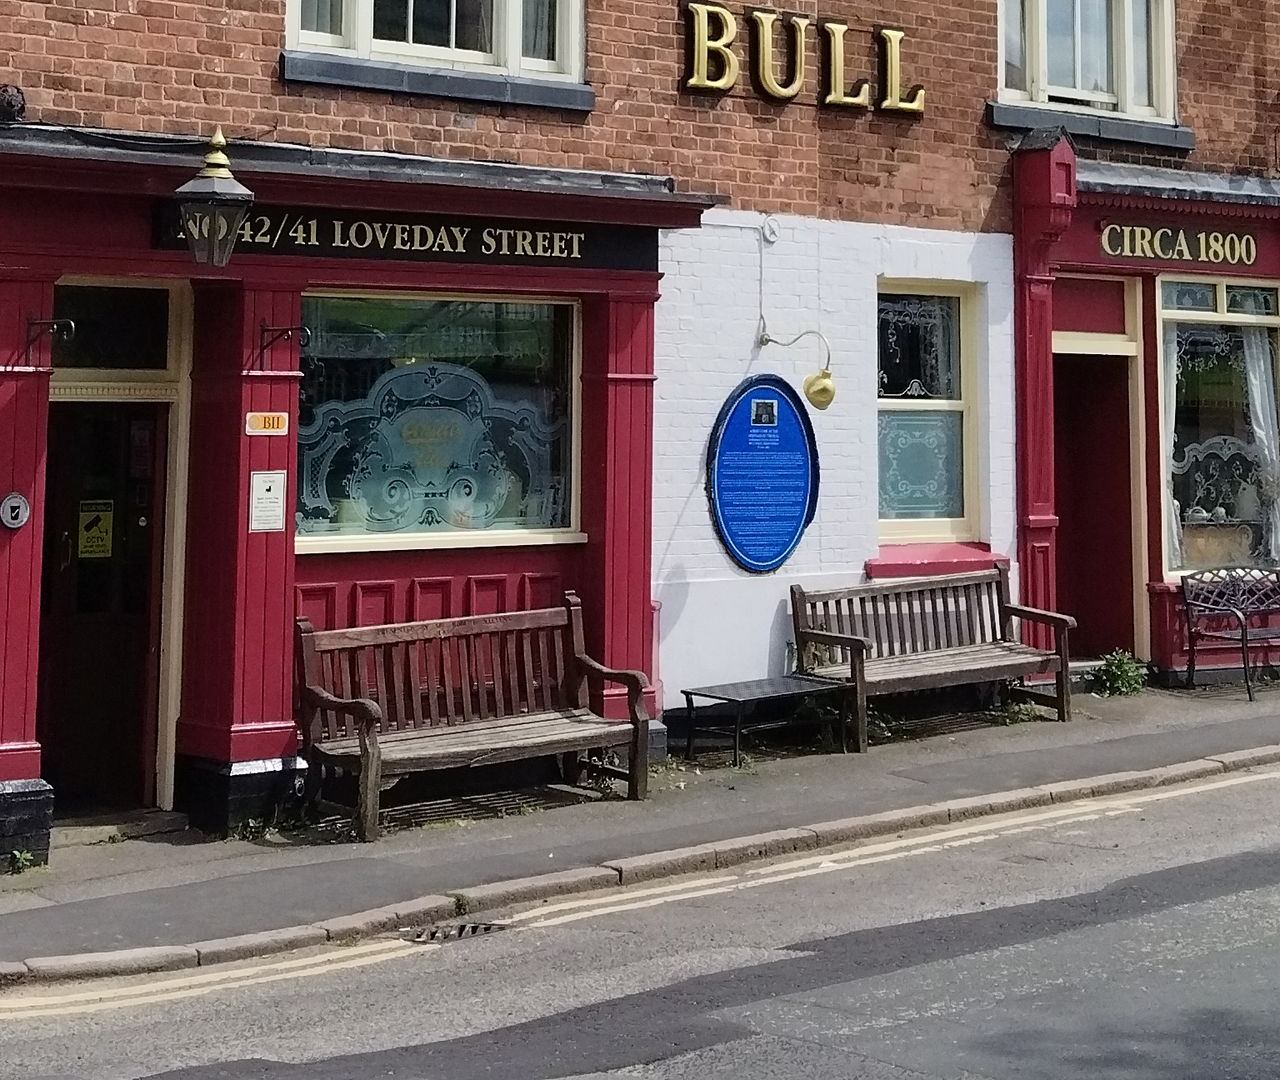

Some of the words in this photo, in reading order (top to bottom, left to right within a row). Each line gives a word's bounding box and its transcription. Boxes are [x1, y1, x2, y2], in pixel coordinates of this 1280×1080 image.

[686, 2, 926, 113] BULL
[237, 212, 320, 248] 42/41
[332, 220, 471, 253] LOVEDAY
[481, 228, 585, 258] STREET
[1101, 224, 1192, 260] CIRCA
[1197, 232, 1257, 265] 1800
[86, 536, 105, 544] CCTV
